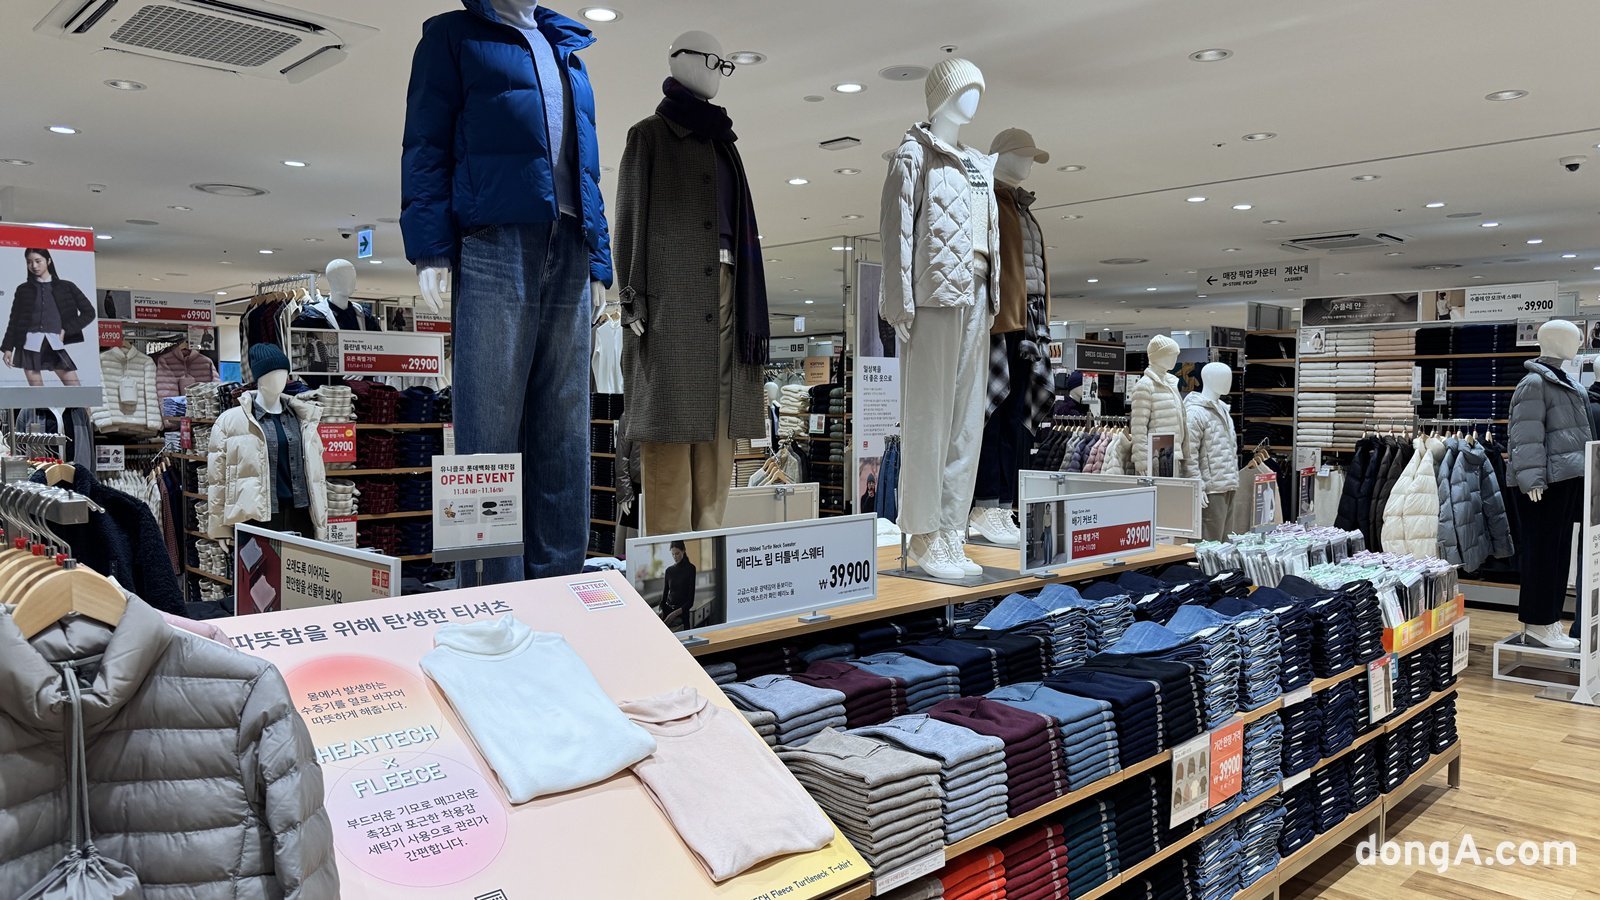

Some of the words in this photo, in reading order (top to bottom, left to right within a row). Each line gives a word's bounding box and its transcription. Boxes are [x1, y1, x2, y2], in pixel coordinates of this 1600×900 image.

[1222, 272, 1237, 280] 매장
[1239, 270, 1253, 279] 픽업
[1255, 267, 1277, 278] 카운터
[1284, 265, 1308, 275] 계산대
[441, 474, 473, 485] OPEN
[477, 472, 515, 483] EVENT
[1072, 516, 1082, 526] 배기
[1083, 515, 1092, 524] 커브
[1093, 513, 1097, 524] 진
[1092, 532, 1100, 540] 가격
[286, 558, 306, 576] 오래도록
[308, 564, 330, 582] 이어지는
[736, 555, 762, 569] 메리노
[765, 553, 772, 566] 립
[775, 549, 799, 564] 터틀넥
[801, 546, 824, 560] 스웨터
[286, 576, 306, 594] 편안함을
[307, 582, 324, 600] 선물해
[325, 588, 342, 604] 보세요
[571, 582, 608, 591] HEATTECH
[737, 586, 759, 595] 고급스러운
[228, 624, 328, 650] 따뜻함을
[332, 617, 382, 637] 위해
[382, 608, 449, 630] 탄생한
[451, 600, 513, 618] 티셔츠
[301, 700, 346, 715] 수증기를
[348, 695, 372, 706] 열로
[372, 689, 405, 701] 바꾸어
[307, 688, 342, 702] 몸에서
[343, 681, 387, 695] 발생하는
[312, 711, 358, 725] 따뜻하게
[360, 701, 407, 716] 해줍니다.
[315, 724, 440, 764] HEATTECH
[351, 763, 447, 798] FLEECE
[347, 809, 396, 830] 부드러운
[397, 800, 434, 816] 기모로
[434, 788, 479, 806] 매끄러운
[366, 822, 403, 840] 촉감과
[406, 812, 441, 830] 포근한
[441, 803, 476, 819] 착용감
[368, 837, 406, 856] 세탁기
[407, 824, 454, 844] 사용으로
[455, 814, 490, 832] 관리가
[404, 836, 468, 862] 간편합니다.
[770, 885, 794, 899] Fleece
[793, 870, 829, 889] Turtleneck
[828, 860, 853, 873] T-shirt
